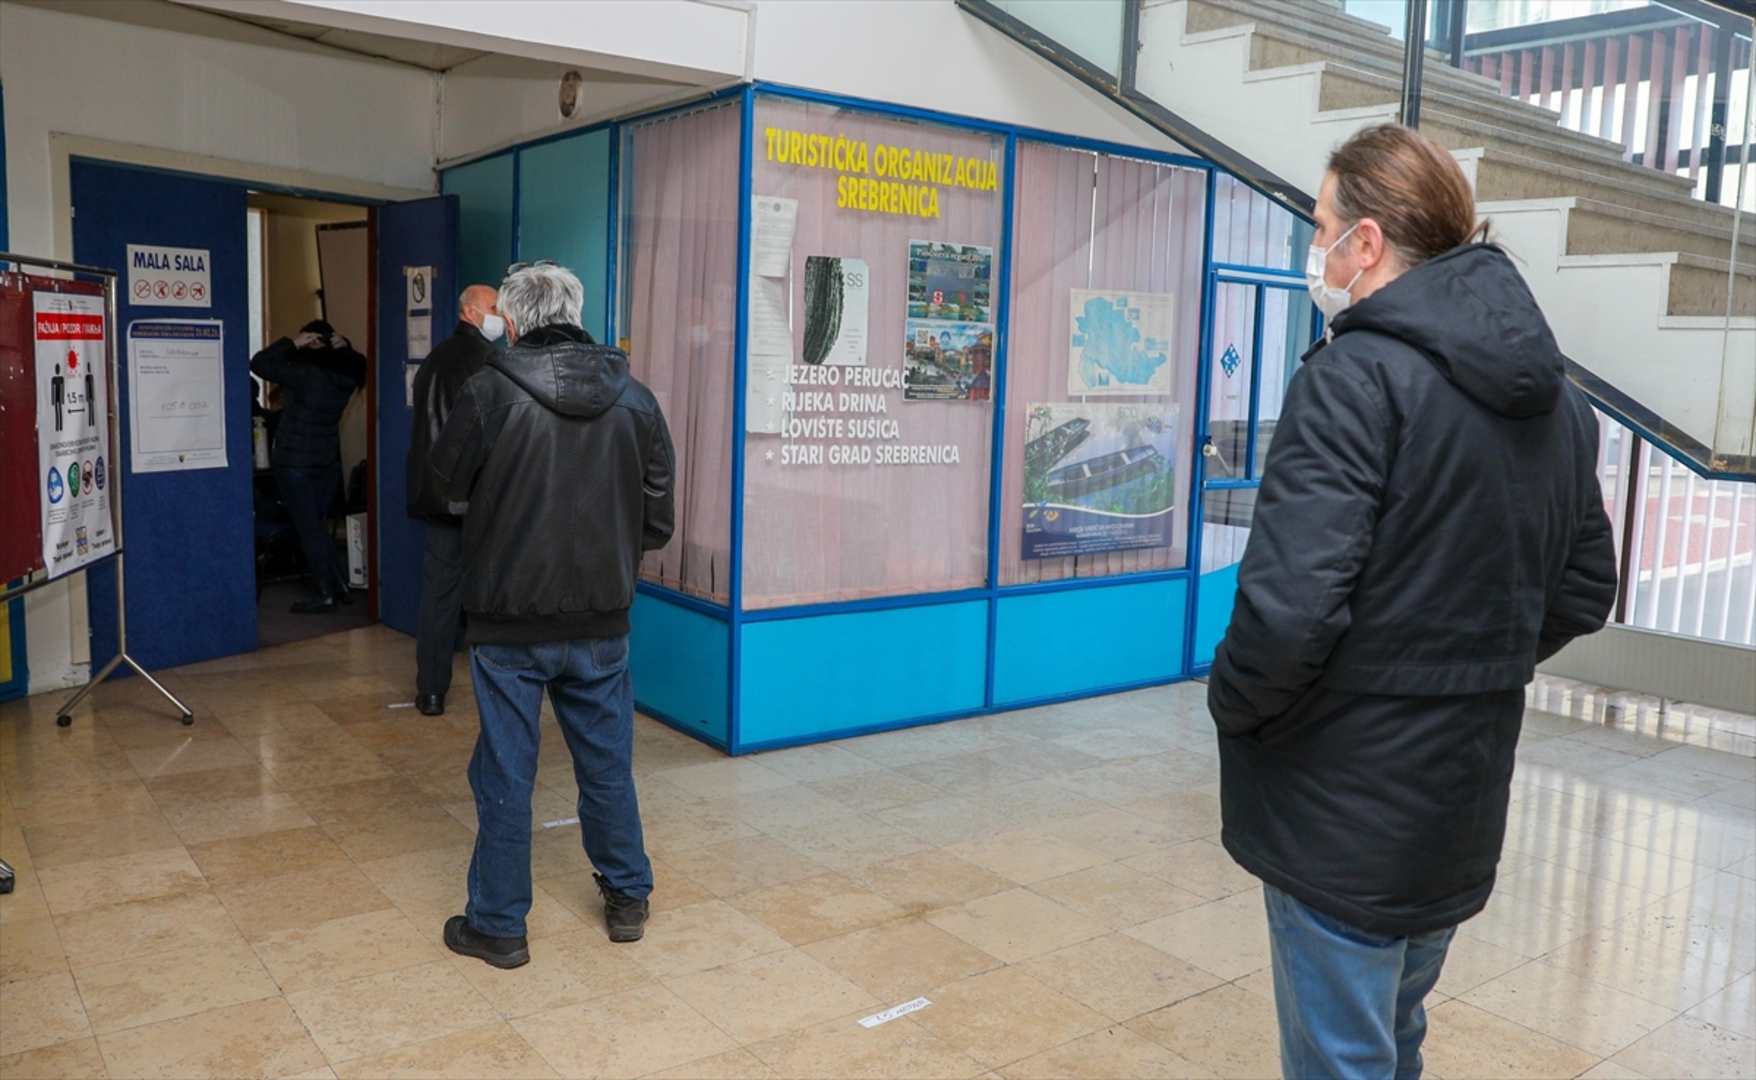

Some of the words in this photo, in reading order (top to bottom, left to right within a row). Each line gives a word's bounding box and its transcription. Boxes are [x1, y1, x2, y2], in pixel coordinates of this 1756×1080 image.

[764, 126, 869, 174] TURISTIČKA
[836, 174, 940, 218] SREBRENICA
[133, 251, 171, 270] MALA
[174, 254, 206, 272] SALA
[846, 272, 864, 287] SS
[782, 364, 840, 385] JEZERO
[844, 365, 910, 389] PERUĆAC
[782, 391, 834, 412] RIJEKA
[839, 392, 887, 413] DRINA
[780, 416, 843, 439] LOVIŠTE
[847, 416, 900, 439] SUŠICA
[780, 444, 824, 465] STARI
[828, 444, 872, 465] GRAD
[875, 444, 960, 465] SREBRENICA
